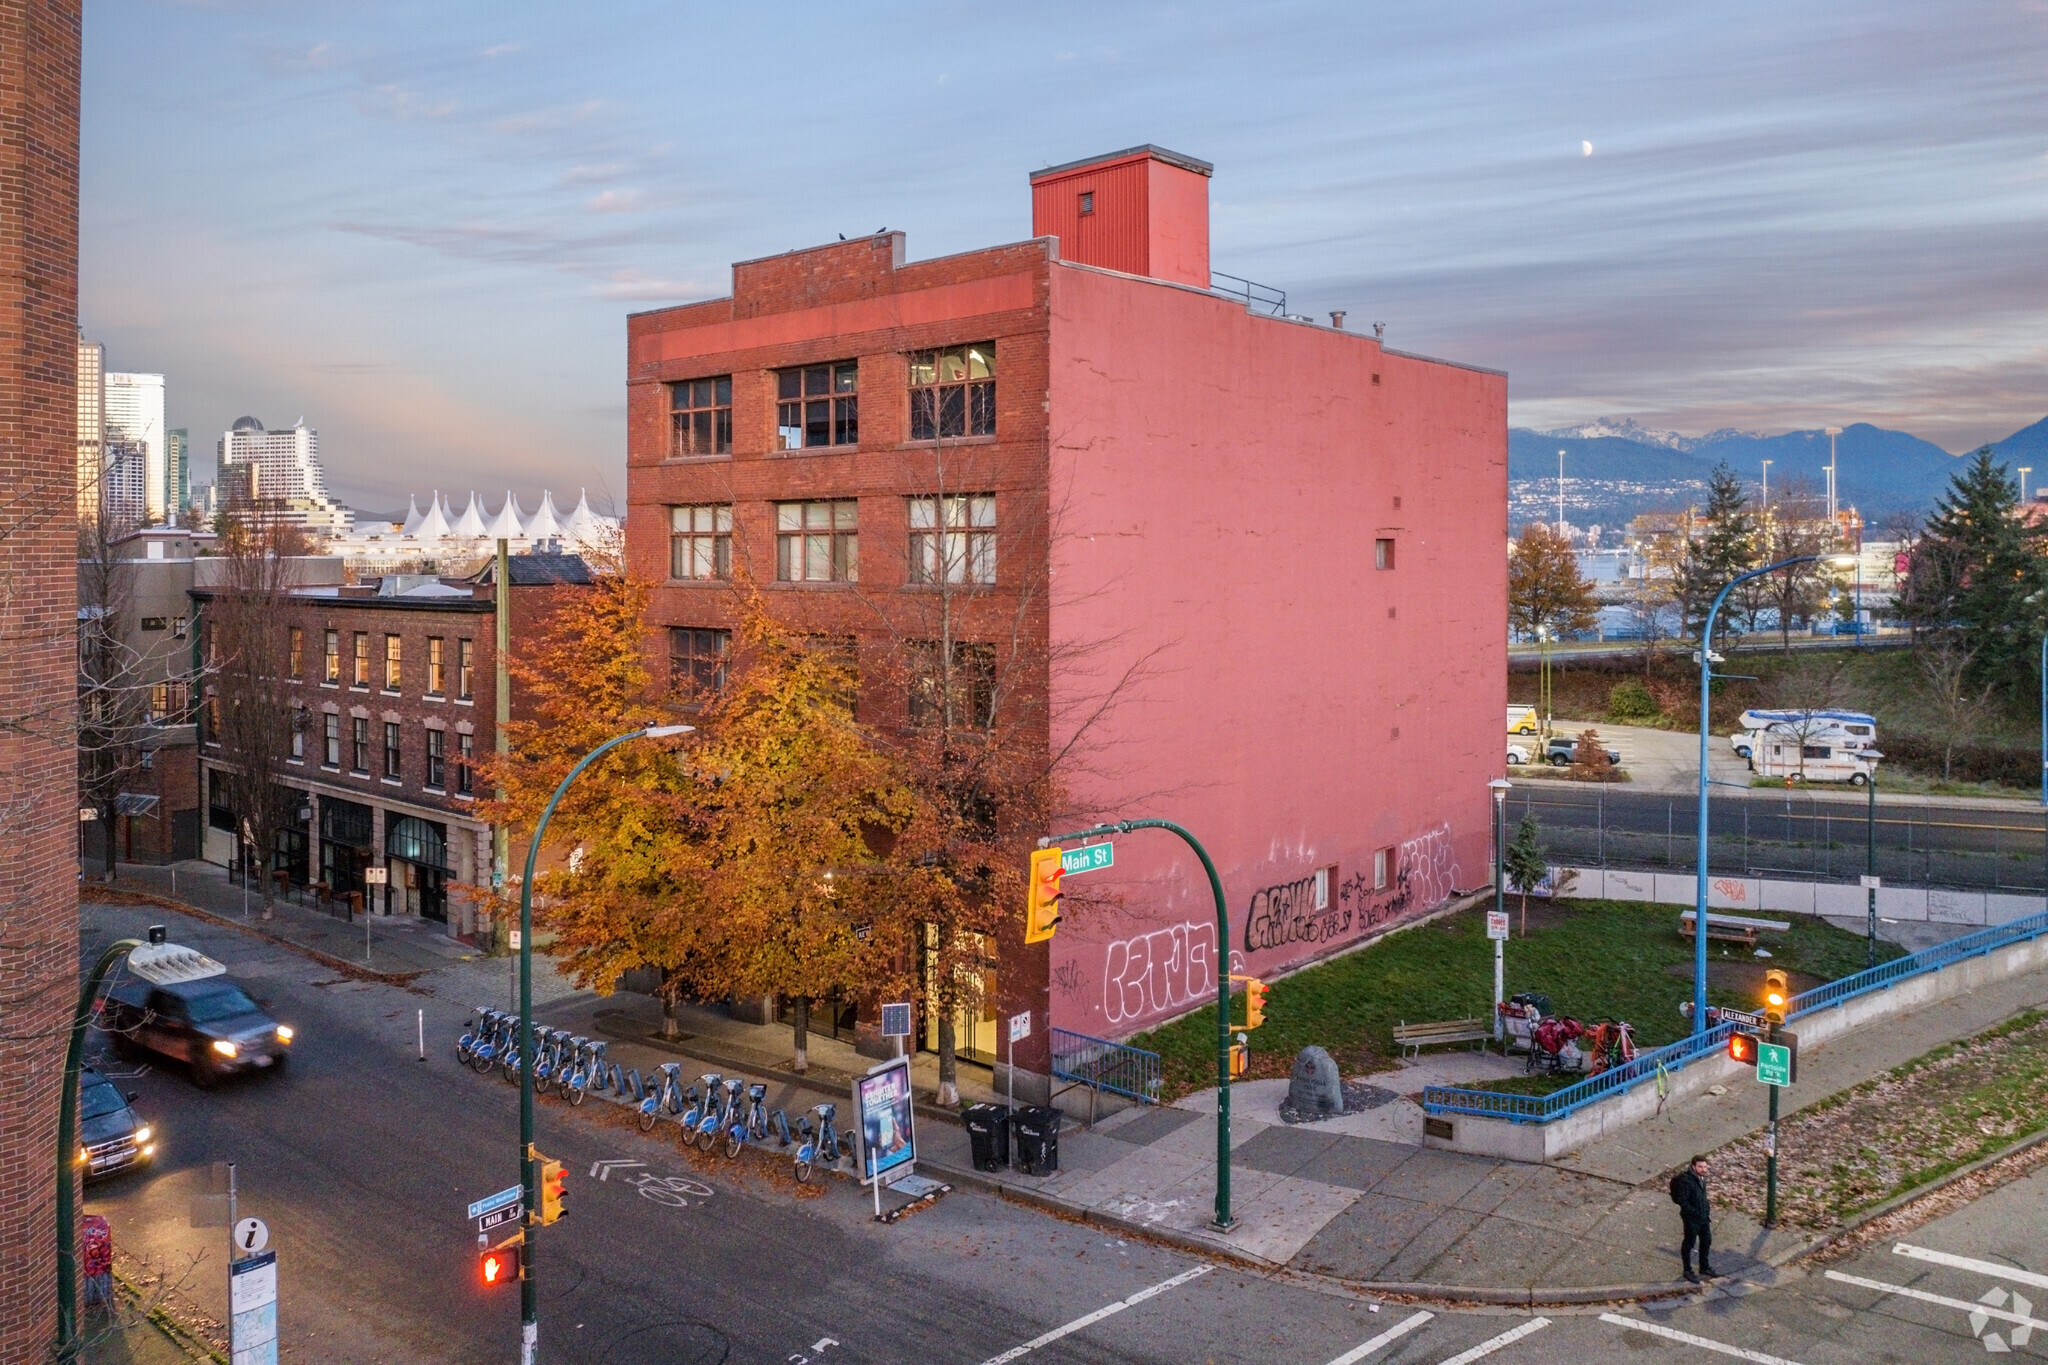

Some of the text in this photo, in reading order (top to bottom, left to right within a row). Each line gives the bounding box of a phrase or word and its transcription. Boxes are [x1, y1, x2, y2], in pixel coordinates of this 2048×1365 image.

[1062, 848, 1107, 871] Main St
[1724, 1010, 1757, 1025] ALEXANDER
[1760, 1062, 1787, 1073] Portside
[865, 1090, 897, 1107] TOGETHER
[485, 1213, 502, 1227] MAIN
